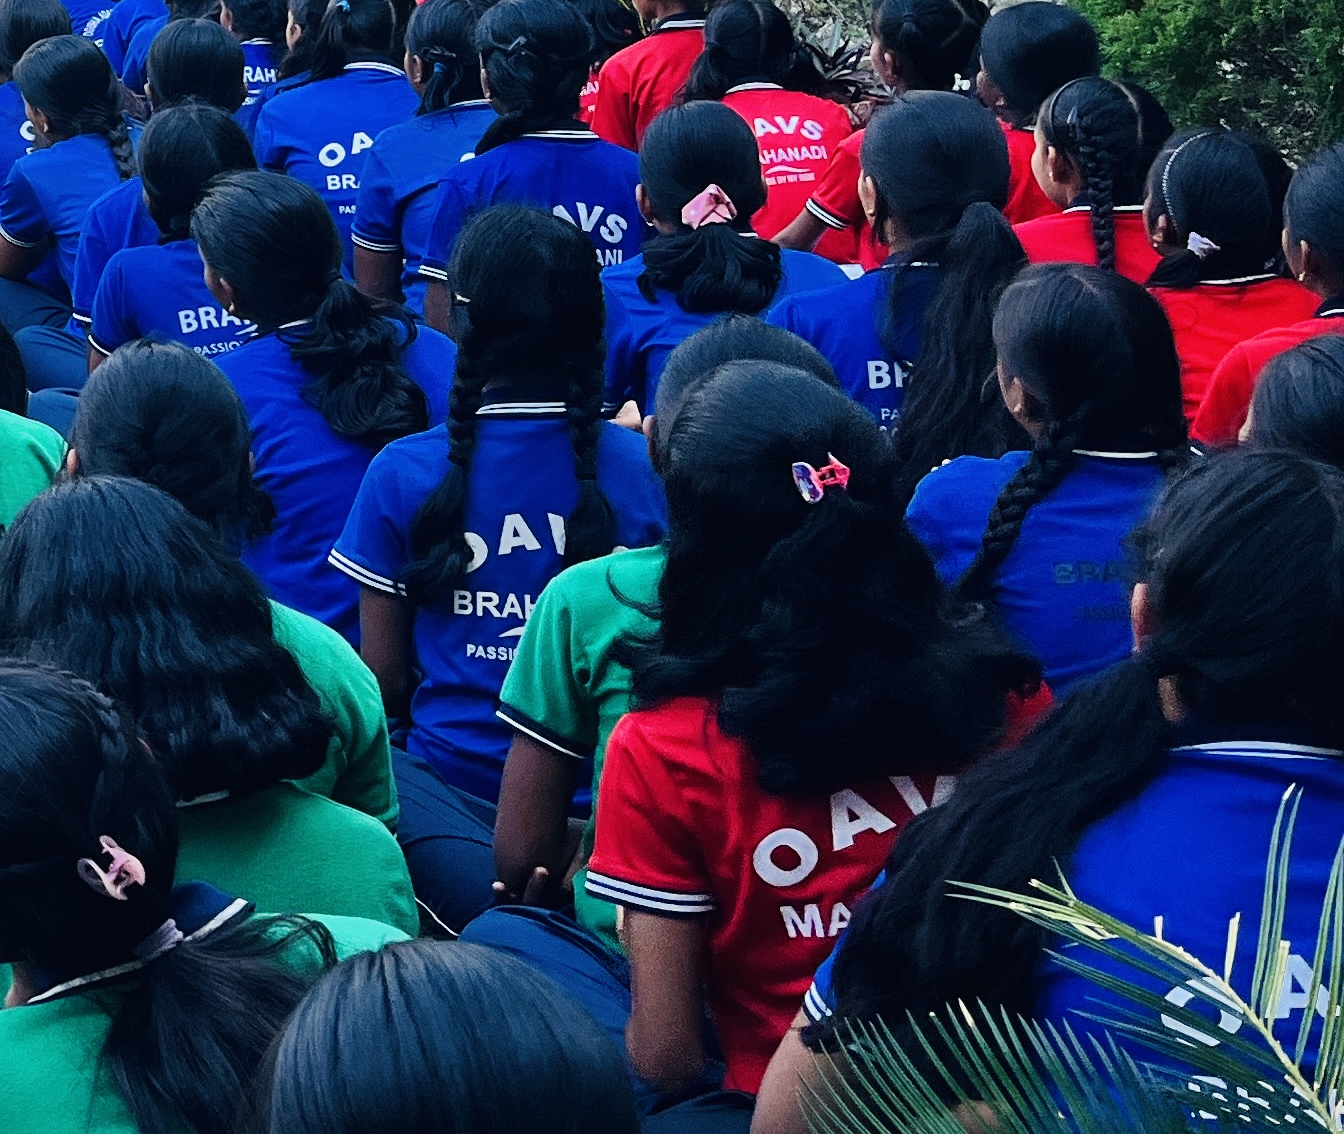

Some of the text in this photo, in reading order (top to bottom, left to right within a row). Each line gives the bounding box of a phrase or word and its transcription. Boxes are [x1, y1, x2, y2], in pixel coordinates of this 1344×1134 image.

[753, 115, 824, 141] AVS
[318, 131, 374, 167] OA
[193, 340, 244, 356] PASSIO
[466, 643, 518, 661] PASSI
[753, 775, 958, 887] OAV
